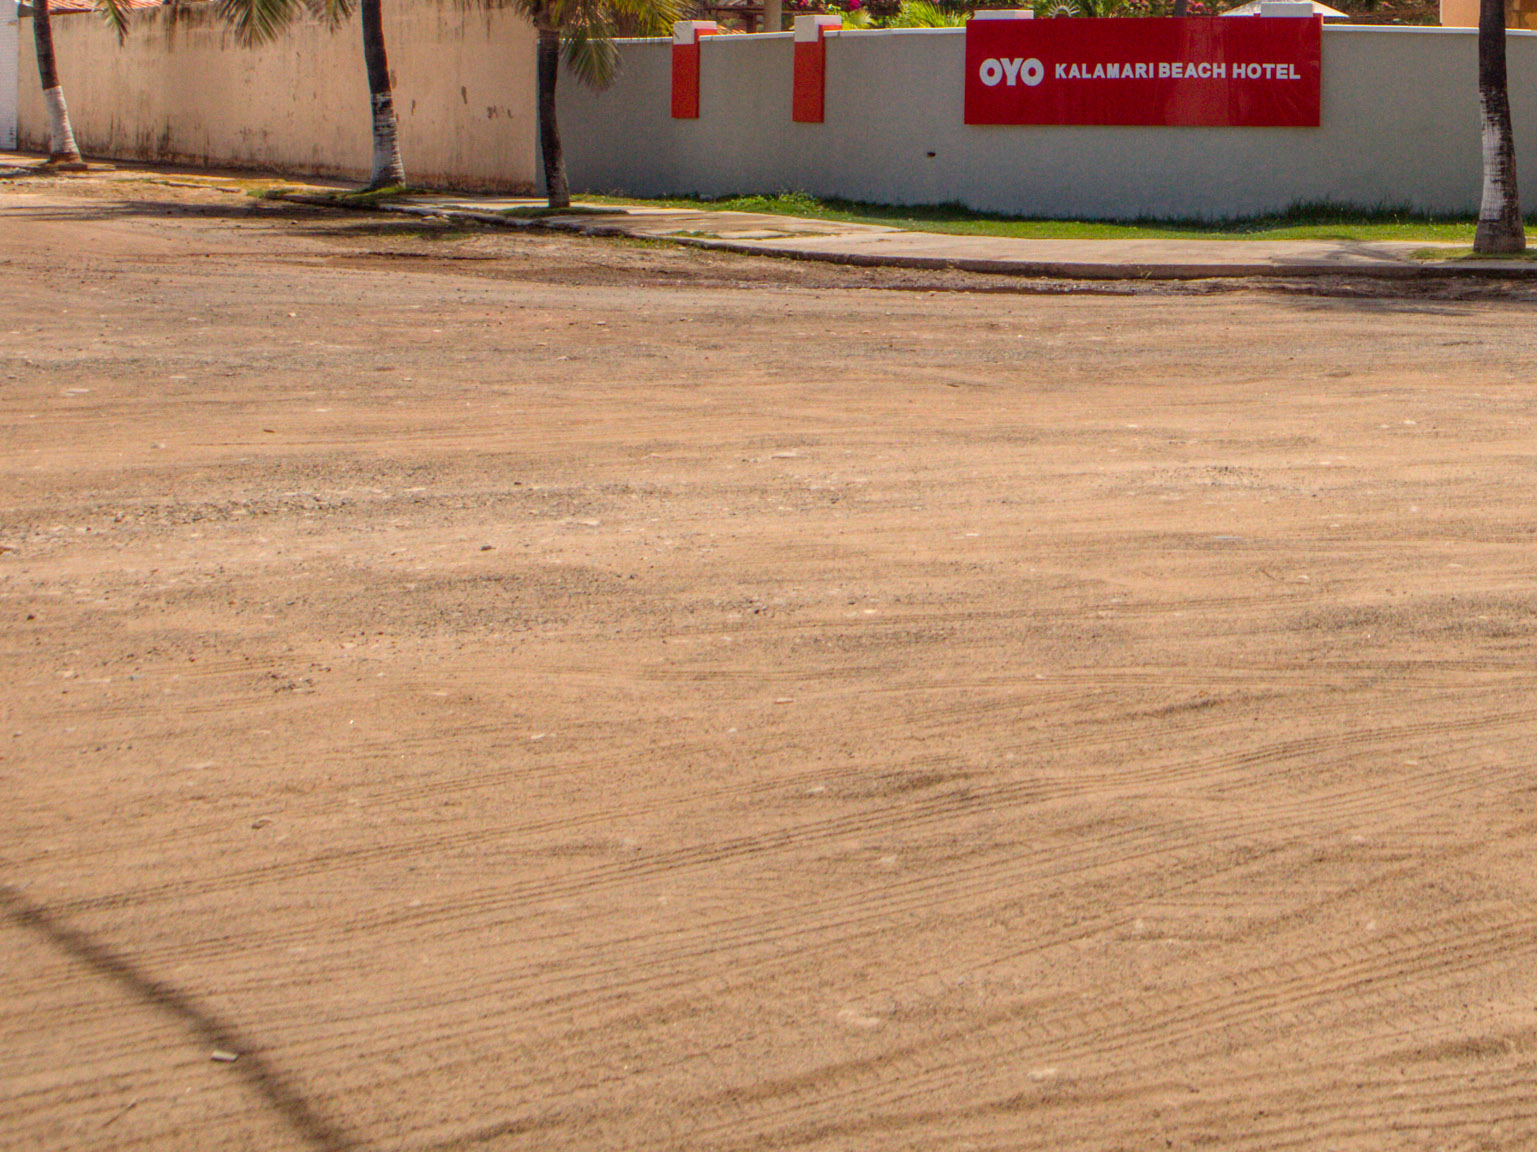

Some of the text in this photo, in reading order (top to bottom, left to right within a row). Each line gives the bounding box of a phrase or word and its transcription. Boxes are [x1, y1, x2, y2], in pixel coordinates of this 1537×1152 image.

[979, 58, 1301, 86] OYO KALAMARI BEACH HOTEL
